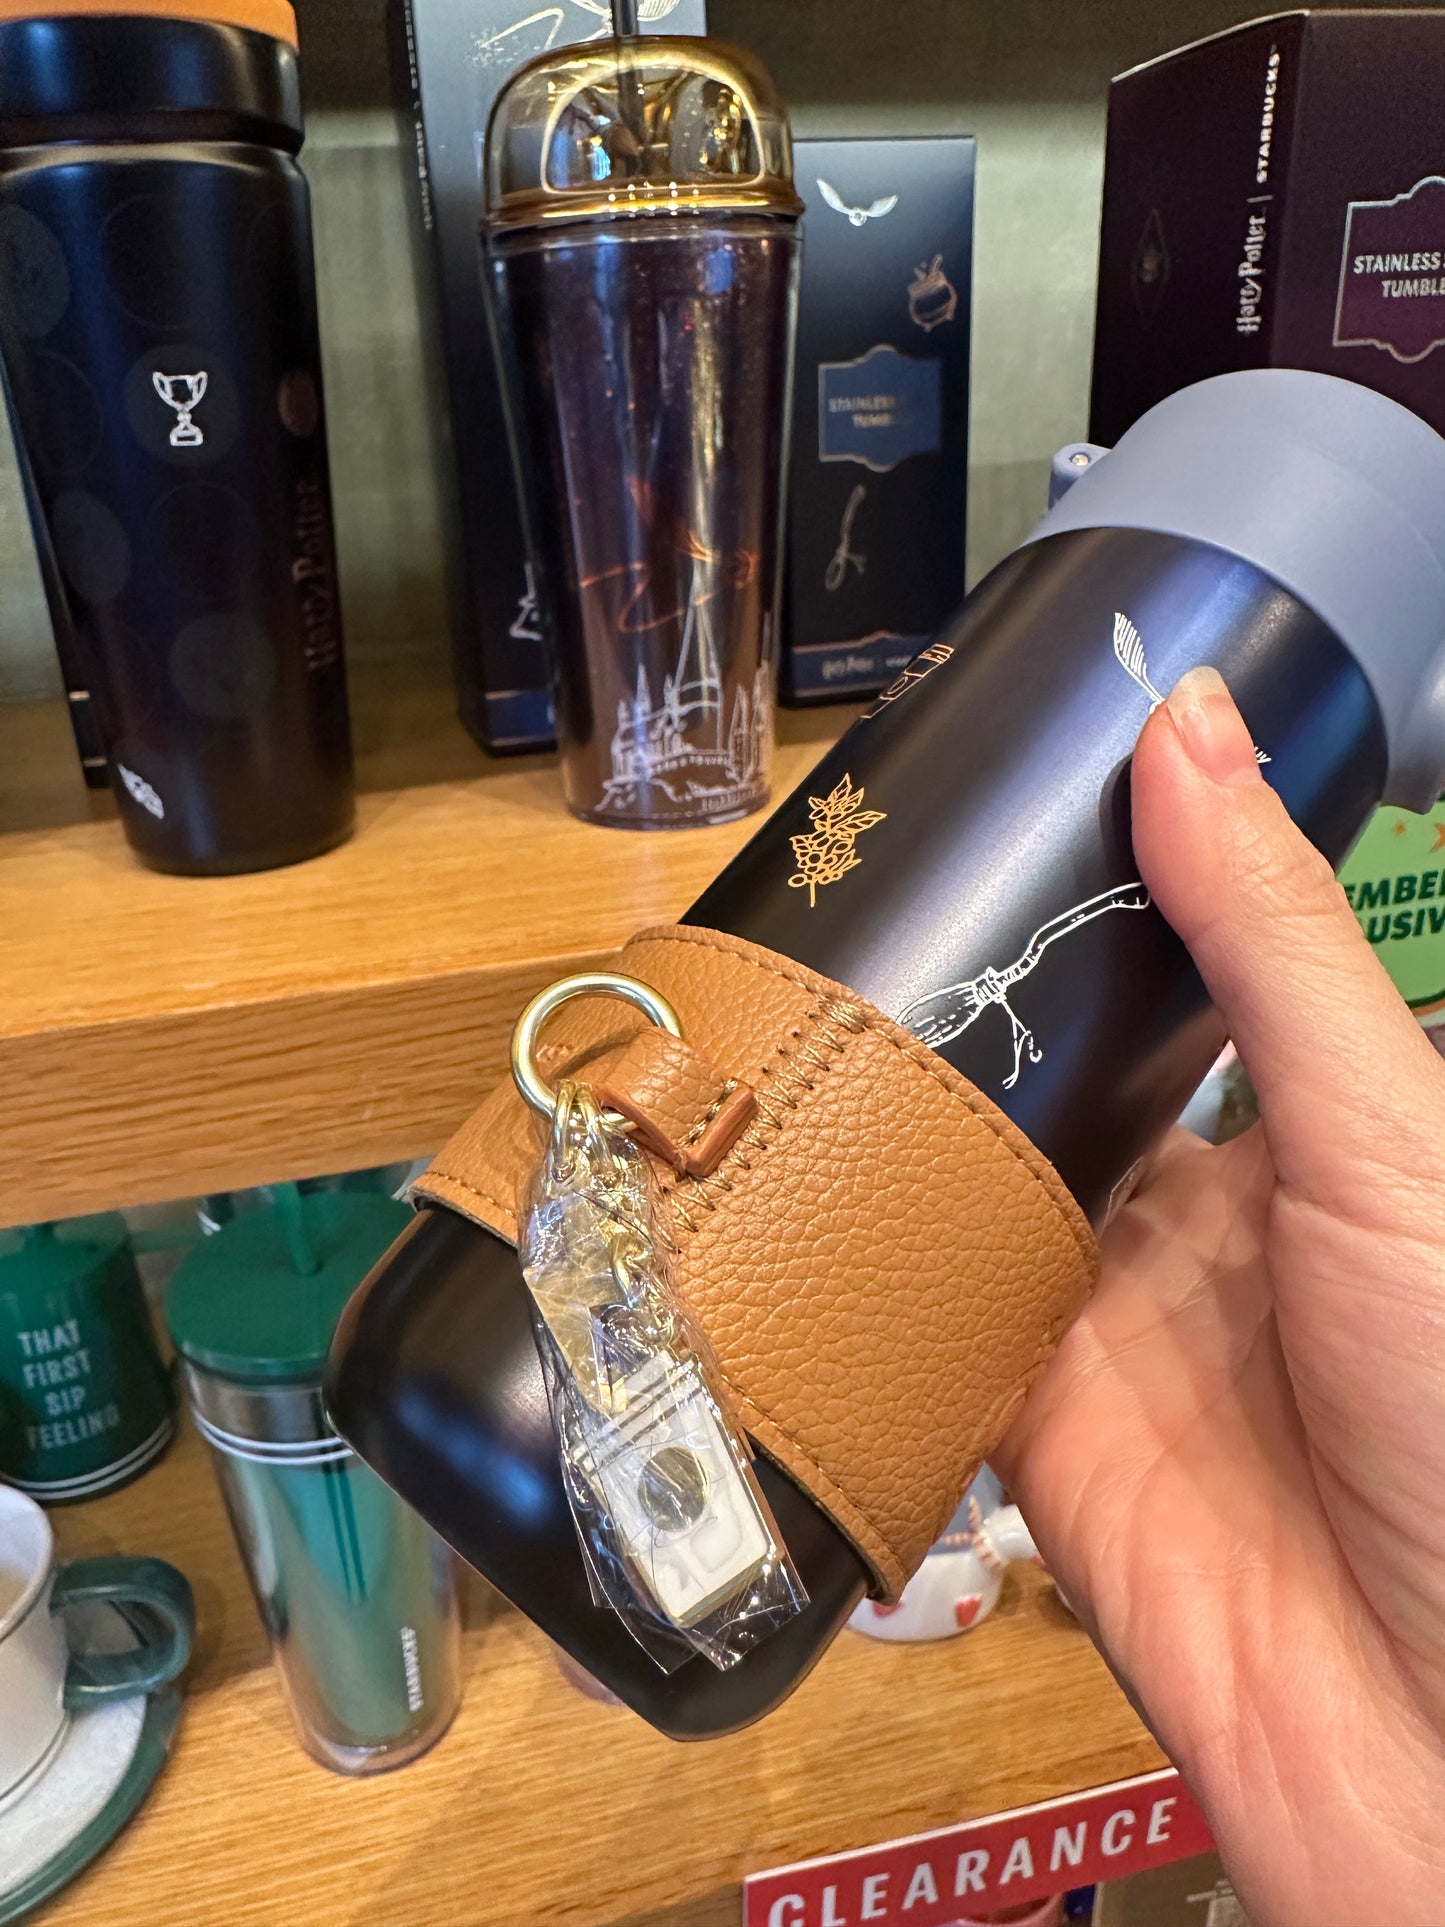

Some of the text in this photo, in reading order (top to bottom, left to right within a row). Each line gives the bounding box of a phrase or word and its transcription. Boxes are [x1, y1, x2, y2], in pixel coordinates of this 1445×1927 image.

[1256, 52, 1281, 184] STARBUCKS
[1353, 251, 1441, 275] STAINLESS
[18, 1322, 80, 1357] THAT
[23, 1350, 91, 1389] FIRST
[45, 1386, 86, 1416] SIP
[767, 1797, 1177, 1927] CLEARANCE
